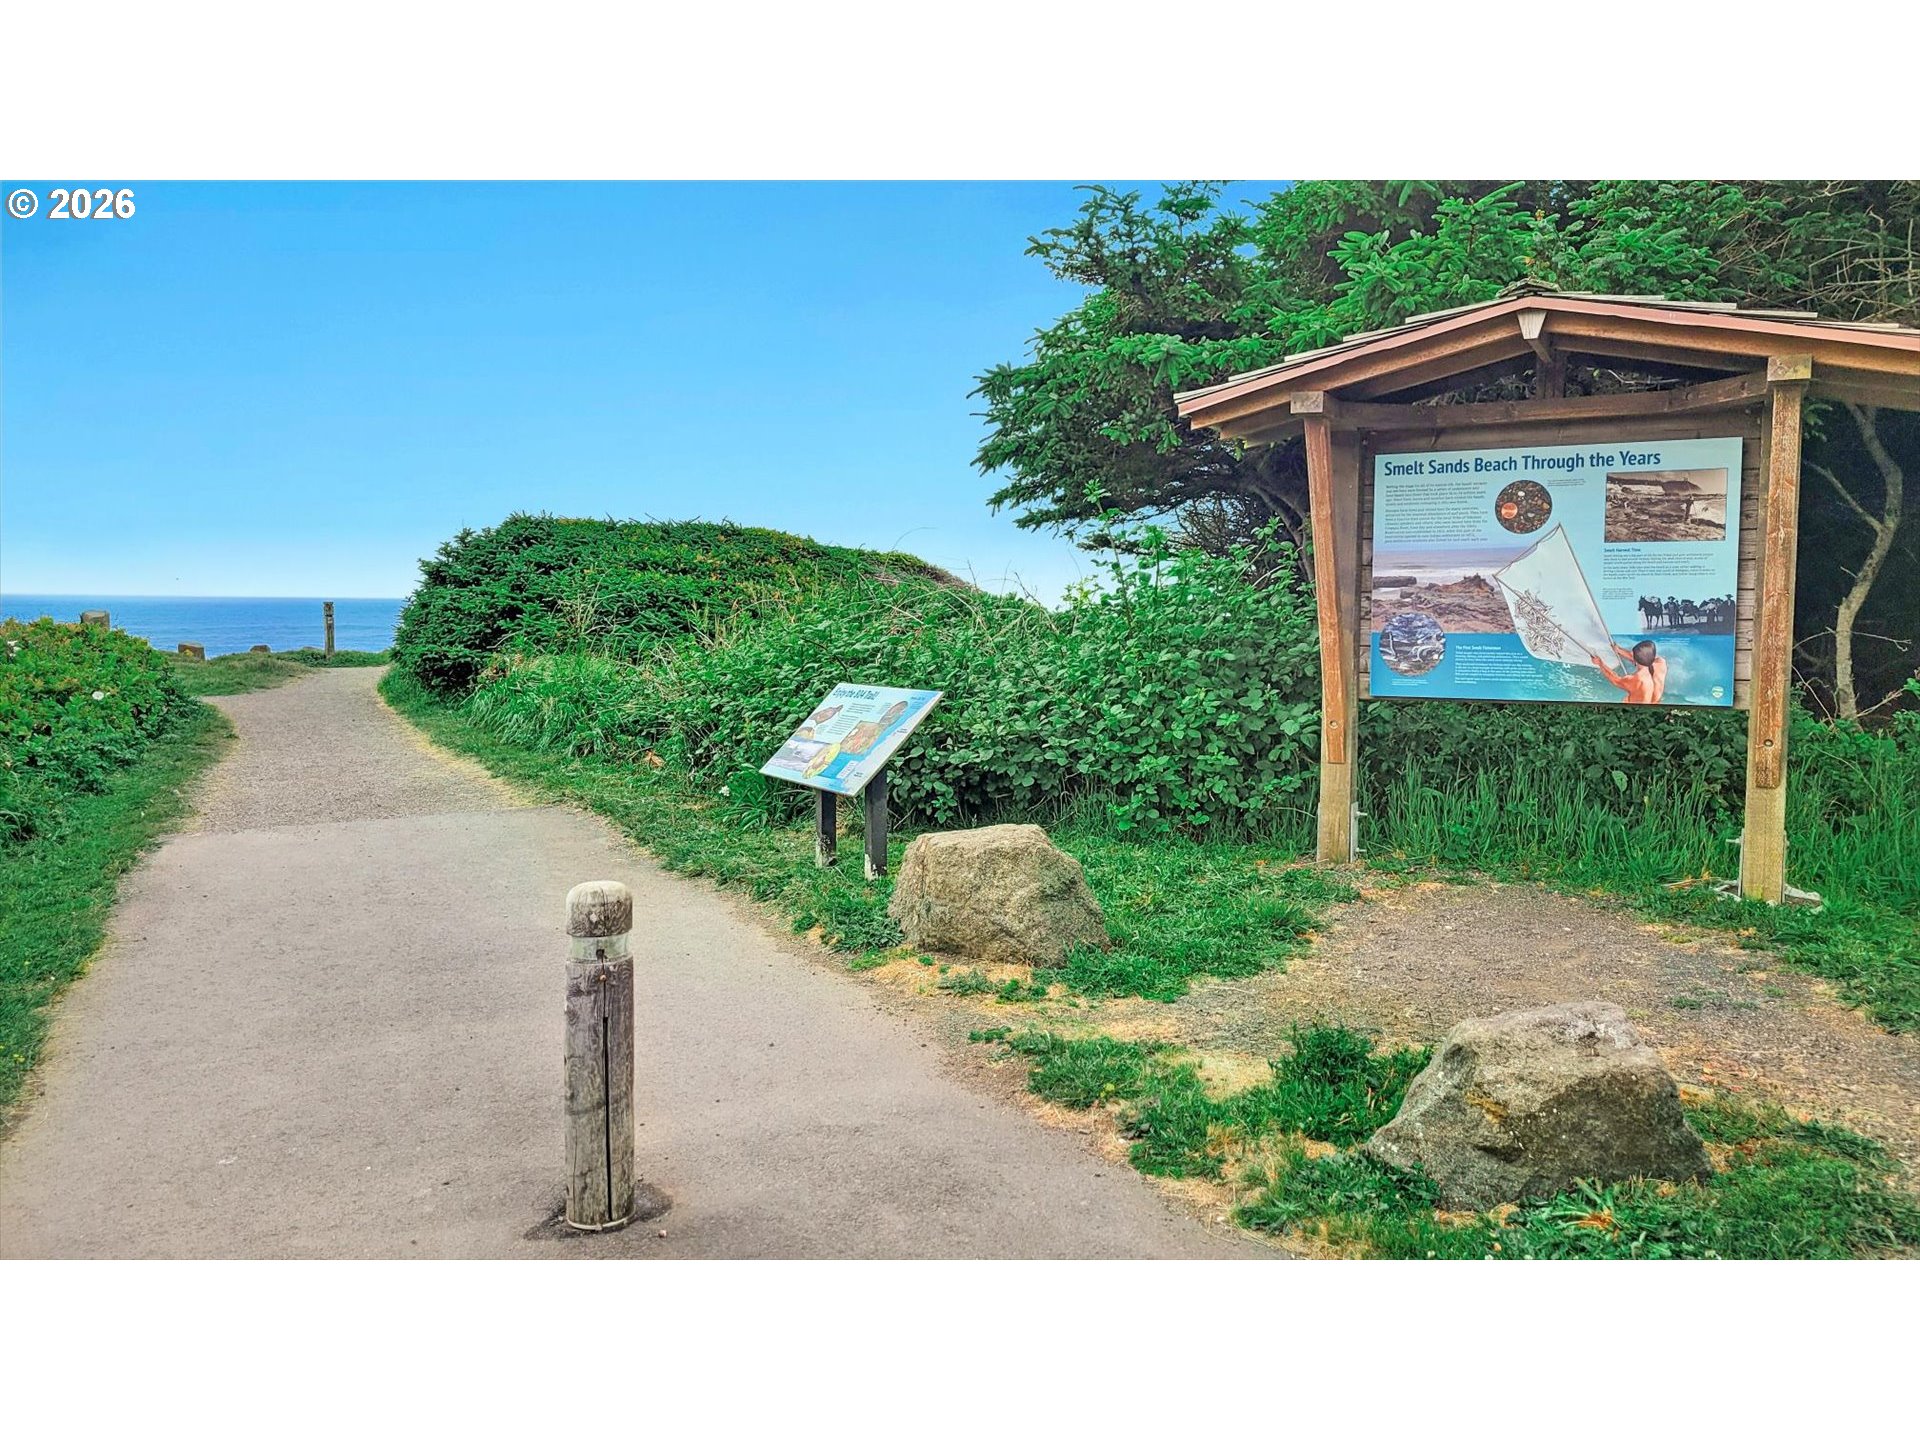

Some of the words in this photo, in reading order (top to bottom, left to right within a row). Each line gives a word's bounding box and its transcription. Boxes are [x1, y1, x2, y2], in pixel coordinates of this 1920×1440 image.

[1384, 460, 1425, 476] Smelt
[1428, 458, 1470, 475] Sands
[1474, 456, 1517, 473] Beach
[1521, 453, 1585, 472] Through
[1589, 452, 1615, 468] the
[1619, 450, 1661, 466] Years
